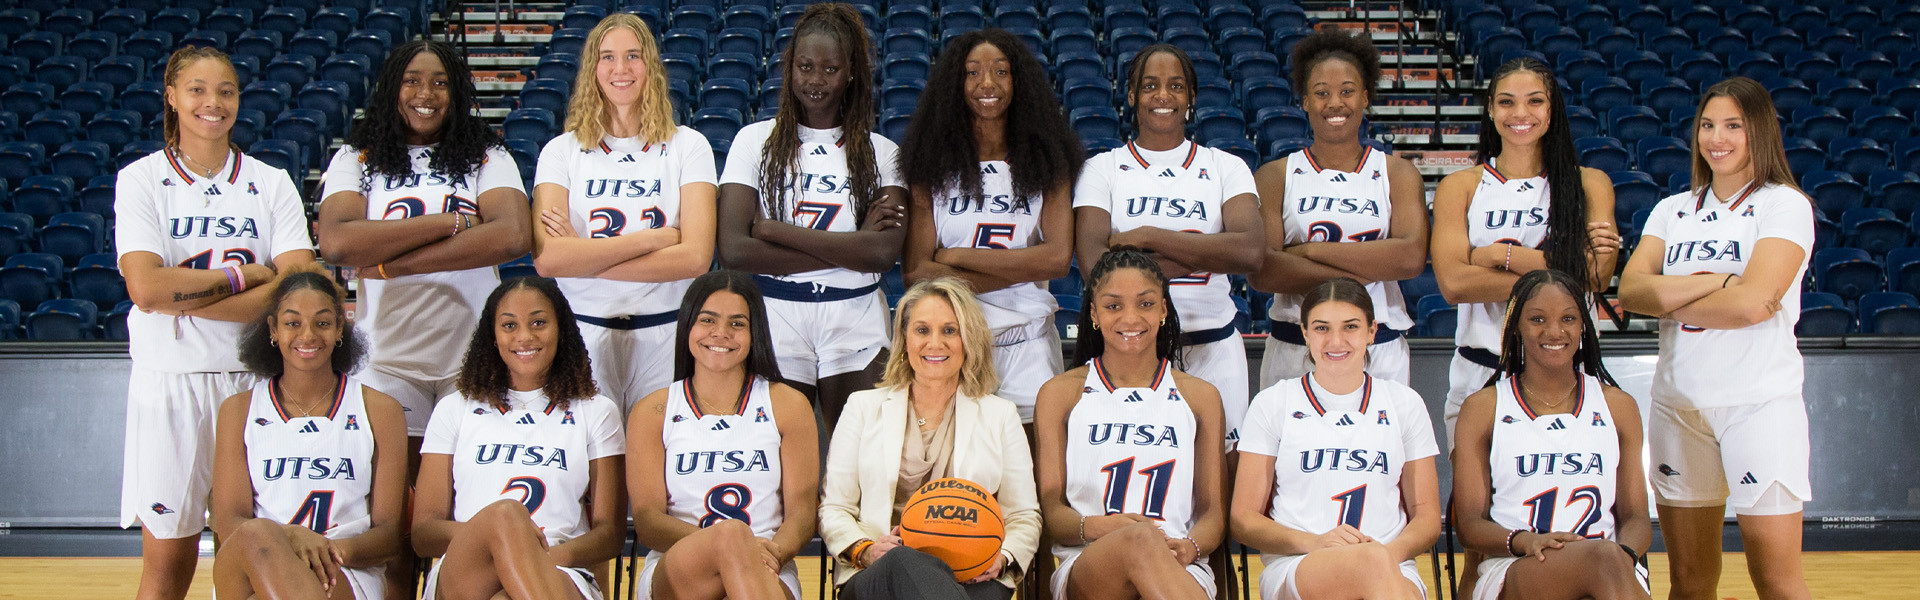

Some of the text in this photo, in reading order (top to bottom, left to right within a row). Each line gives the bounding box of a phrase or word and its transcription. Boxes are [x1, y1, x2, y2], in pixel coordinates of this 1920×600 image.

[583, 178, 661, 199] UTSA
[949, 194, 1032, 216] UTSA
[1126, 196, 1207, 221] UTSA
[1297, 195, 1380, 218] UTSA
[1484, 206, 1550, 230] UTS
[169, 216, 259, 240] UTSA
[1666, 239, 1742, 267] UTSA
[1088, 422, 1179, 449] UTSA
[262, 456, 356, 482] UTSA
[475, 443, 569, 471] UTSA
[675, 449, 770, 476] UTSA
[1300, 447, 1389, 475] UTSA
[1514, 452, 1604, 478] UTSA
[920, 479, 988, 502] Wilson
[1100, 455, 1176, 522] 11
[699, 482, 753, 529] 8
[924, 504, 979, 524] NCAA
[1331, 483, 1367, 531] 1
[1522, 485, 1606, 540] 12
